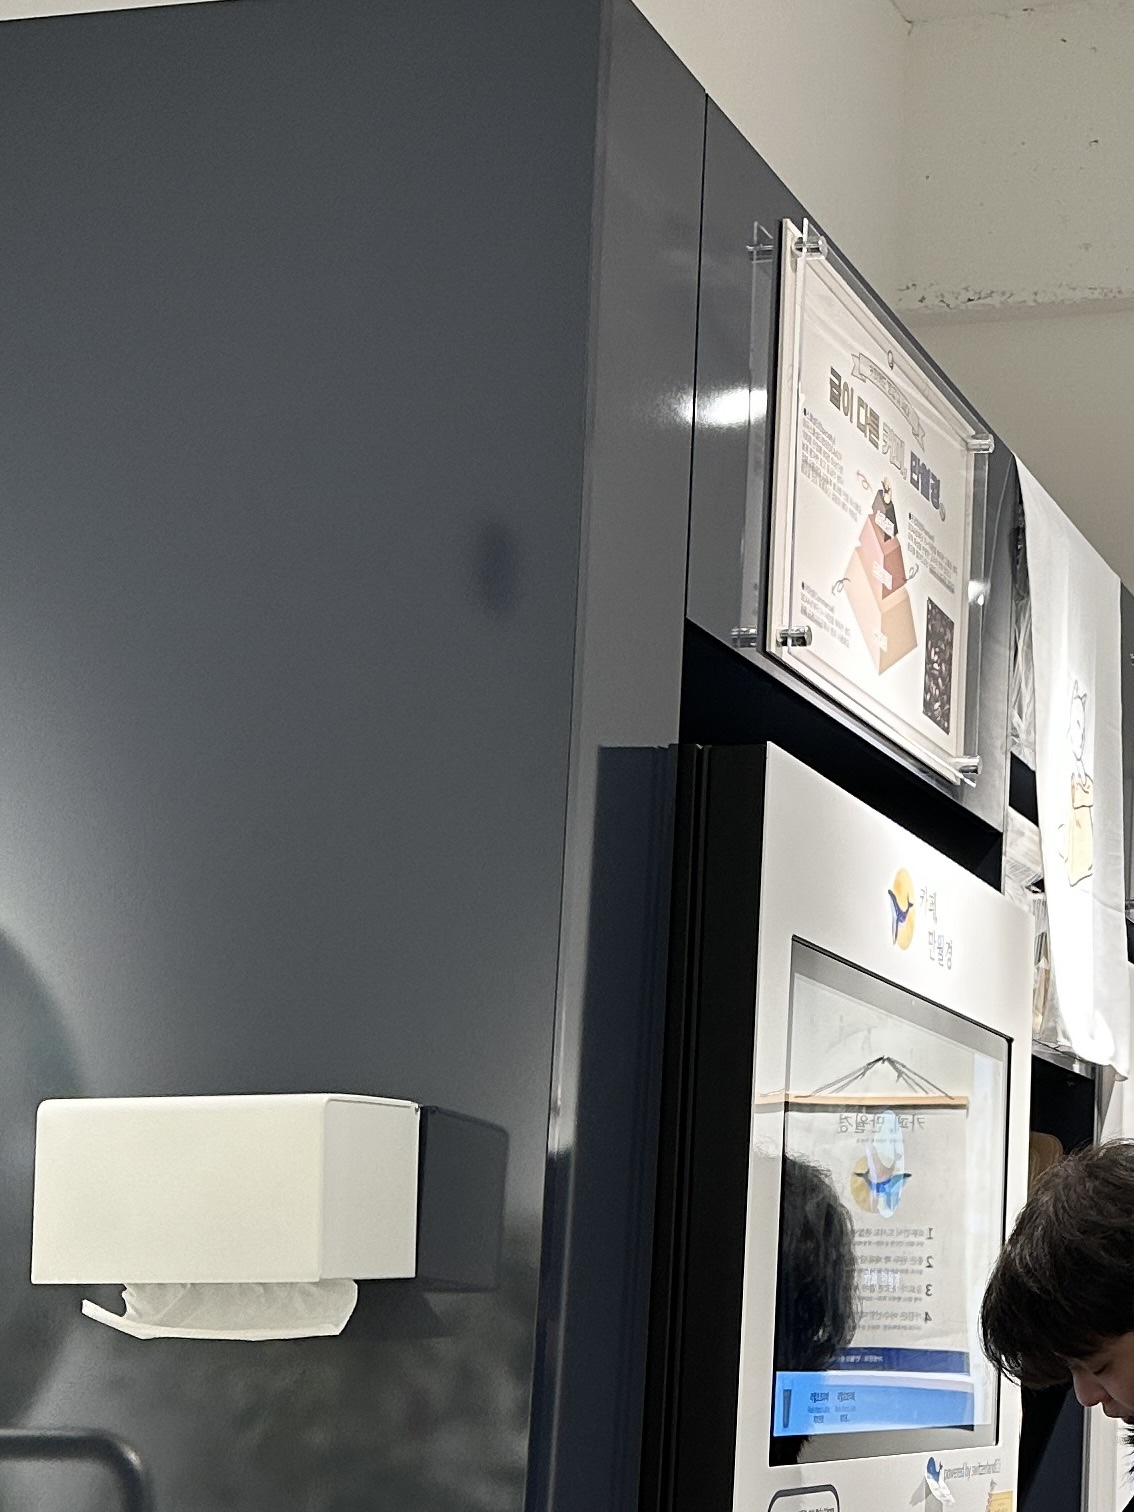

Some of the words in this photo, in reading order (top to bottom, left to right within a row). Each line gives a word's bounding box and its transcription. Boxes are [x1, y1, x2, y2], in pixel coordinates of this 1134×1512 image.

[830, 366, 854, 423] 급이
[857, 395, 880, 450] 다른
[927, 929, 953, 970] 만월경
